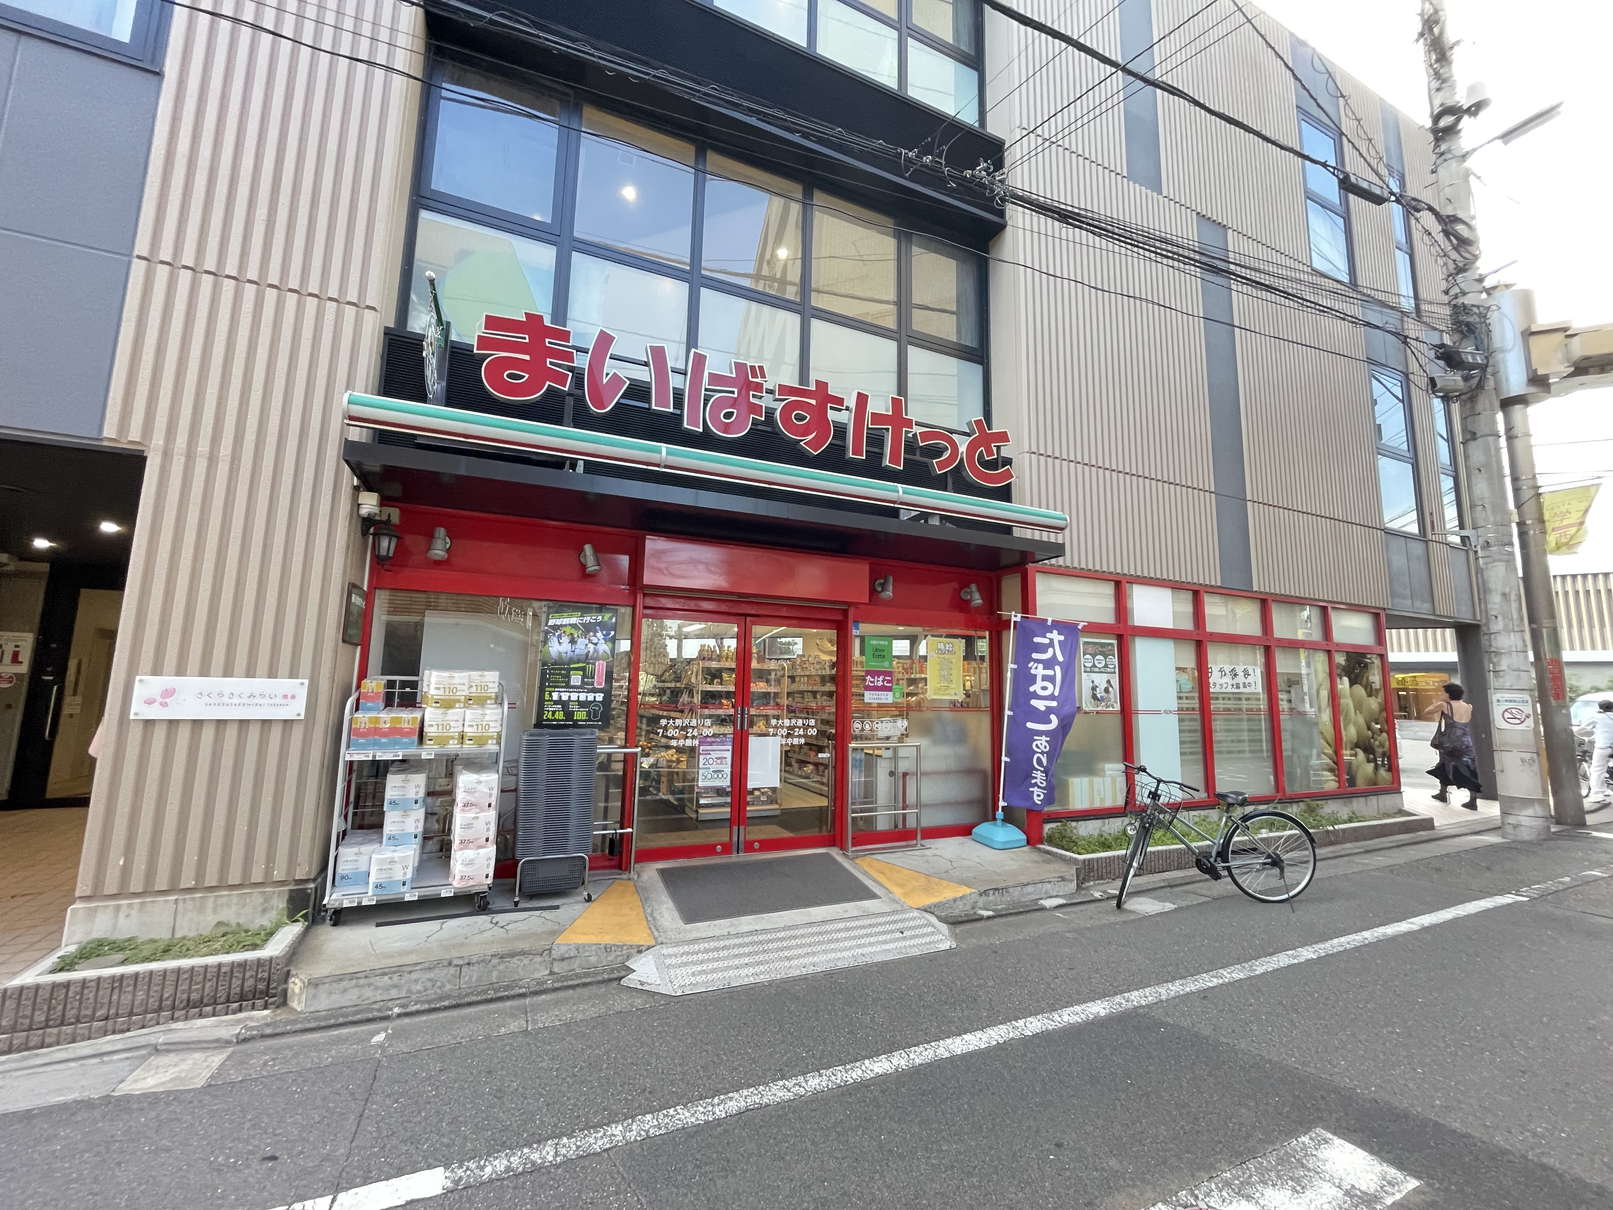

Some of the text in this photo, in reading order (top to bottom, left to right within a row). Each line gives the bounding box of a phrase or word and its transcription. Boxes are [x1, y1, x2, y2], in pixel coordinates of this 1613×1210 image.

[474, 311, 1016, 487] まいばすけっと
[865, 675, 892, 686] たばこ
